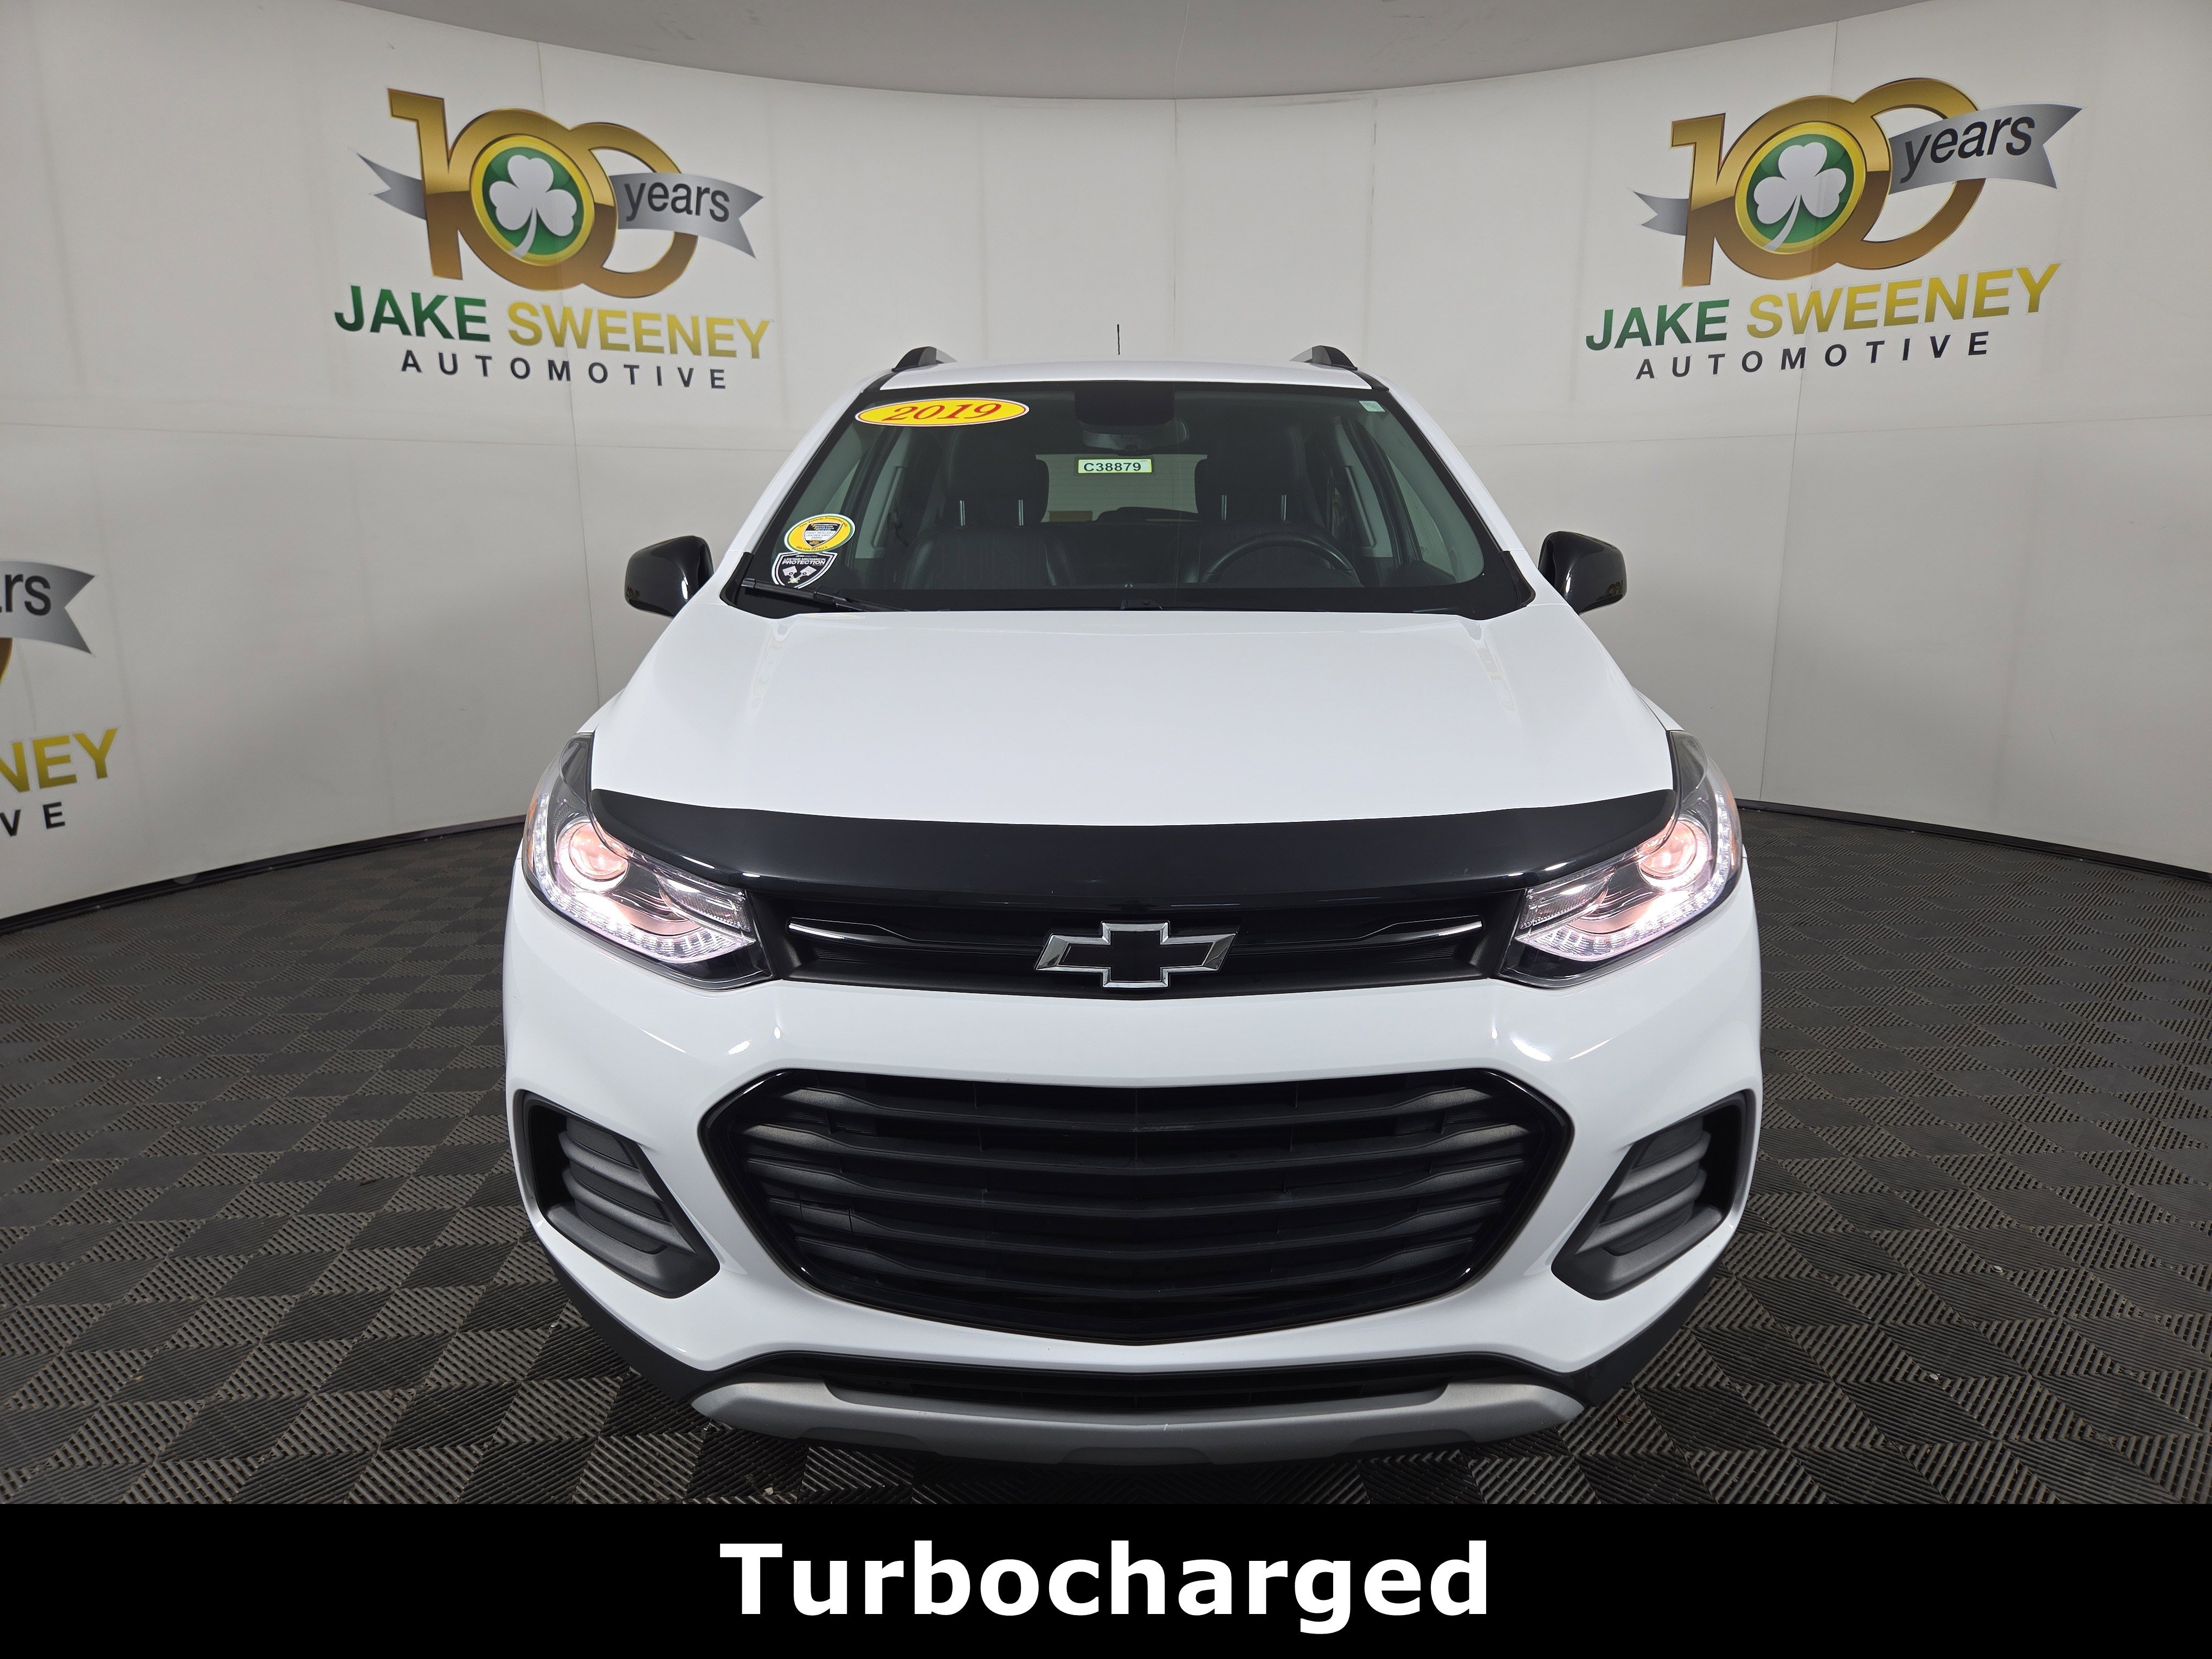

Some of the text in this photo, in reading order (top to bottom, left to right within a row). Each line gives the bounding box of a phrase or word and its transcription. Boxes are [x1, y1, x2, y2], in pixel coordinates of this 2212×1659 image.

[388, 88, 730, 298] 100 years
[1670, 76, 2035, 288] 100 years
[335, 285, 770, 359] JAKE SWEENEY
[1586, 263, 2060, 351] JAKE SWEENEY
[401, 350, 725, 389] AUTOMOTIVE
[1636, 331, 1989, 380] AUTOMOTIVE
[882, 403, 1001, 421] 2019
[1084, 462, 1141, 471] C38879
[0, 574, 52, 616] rs
